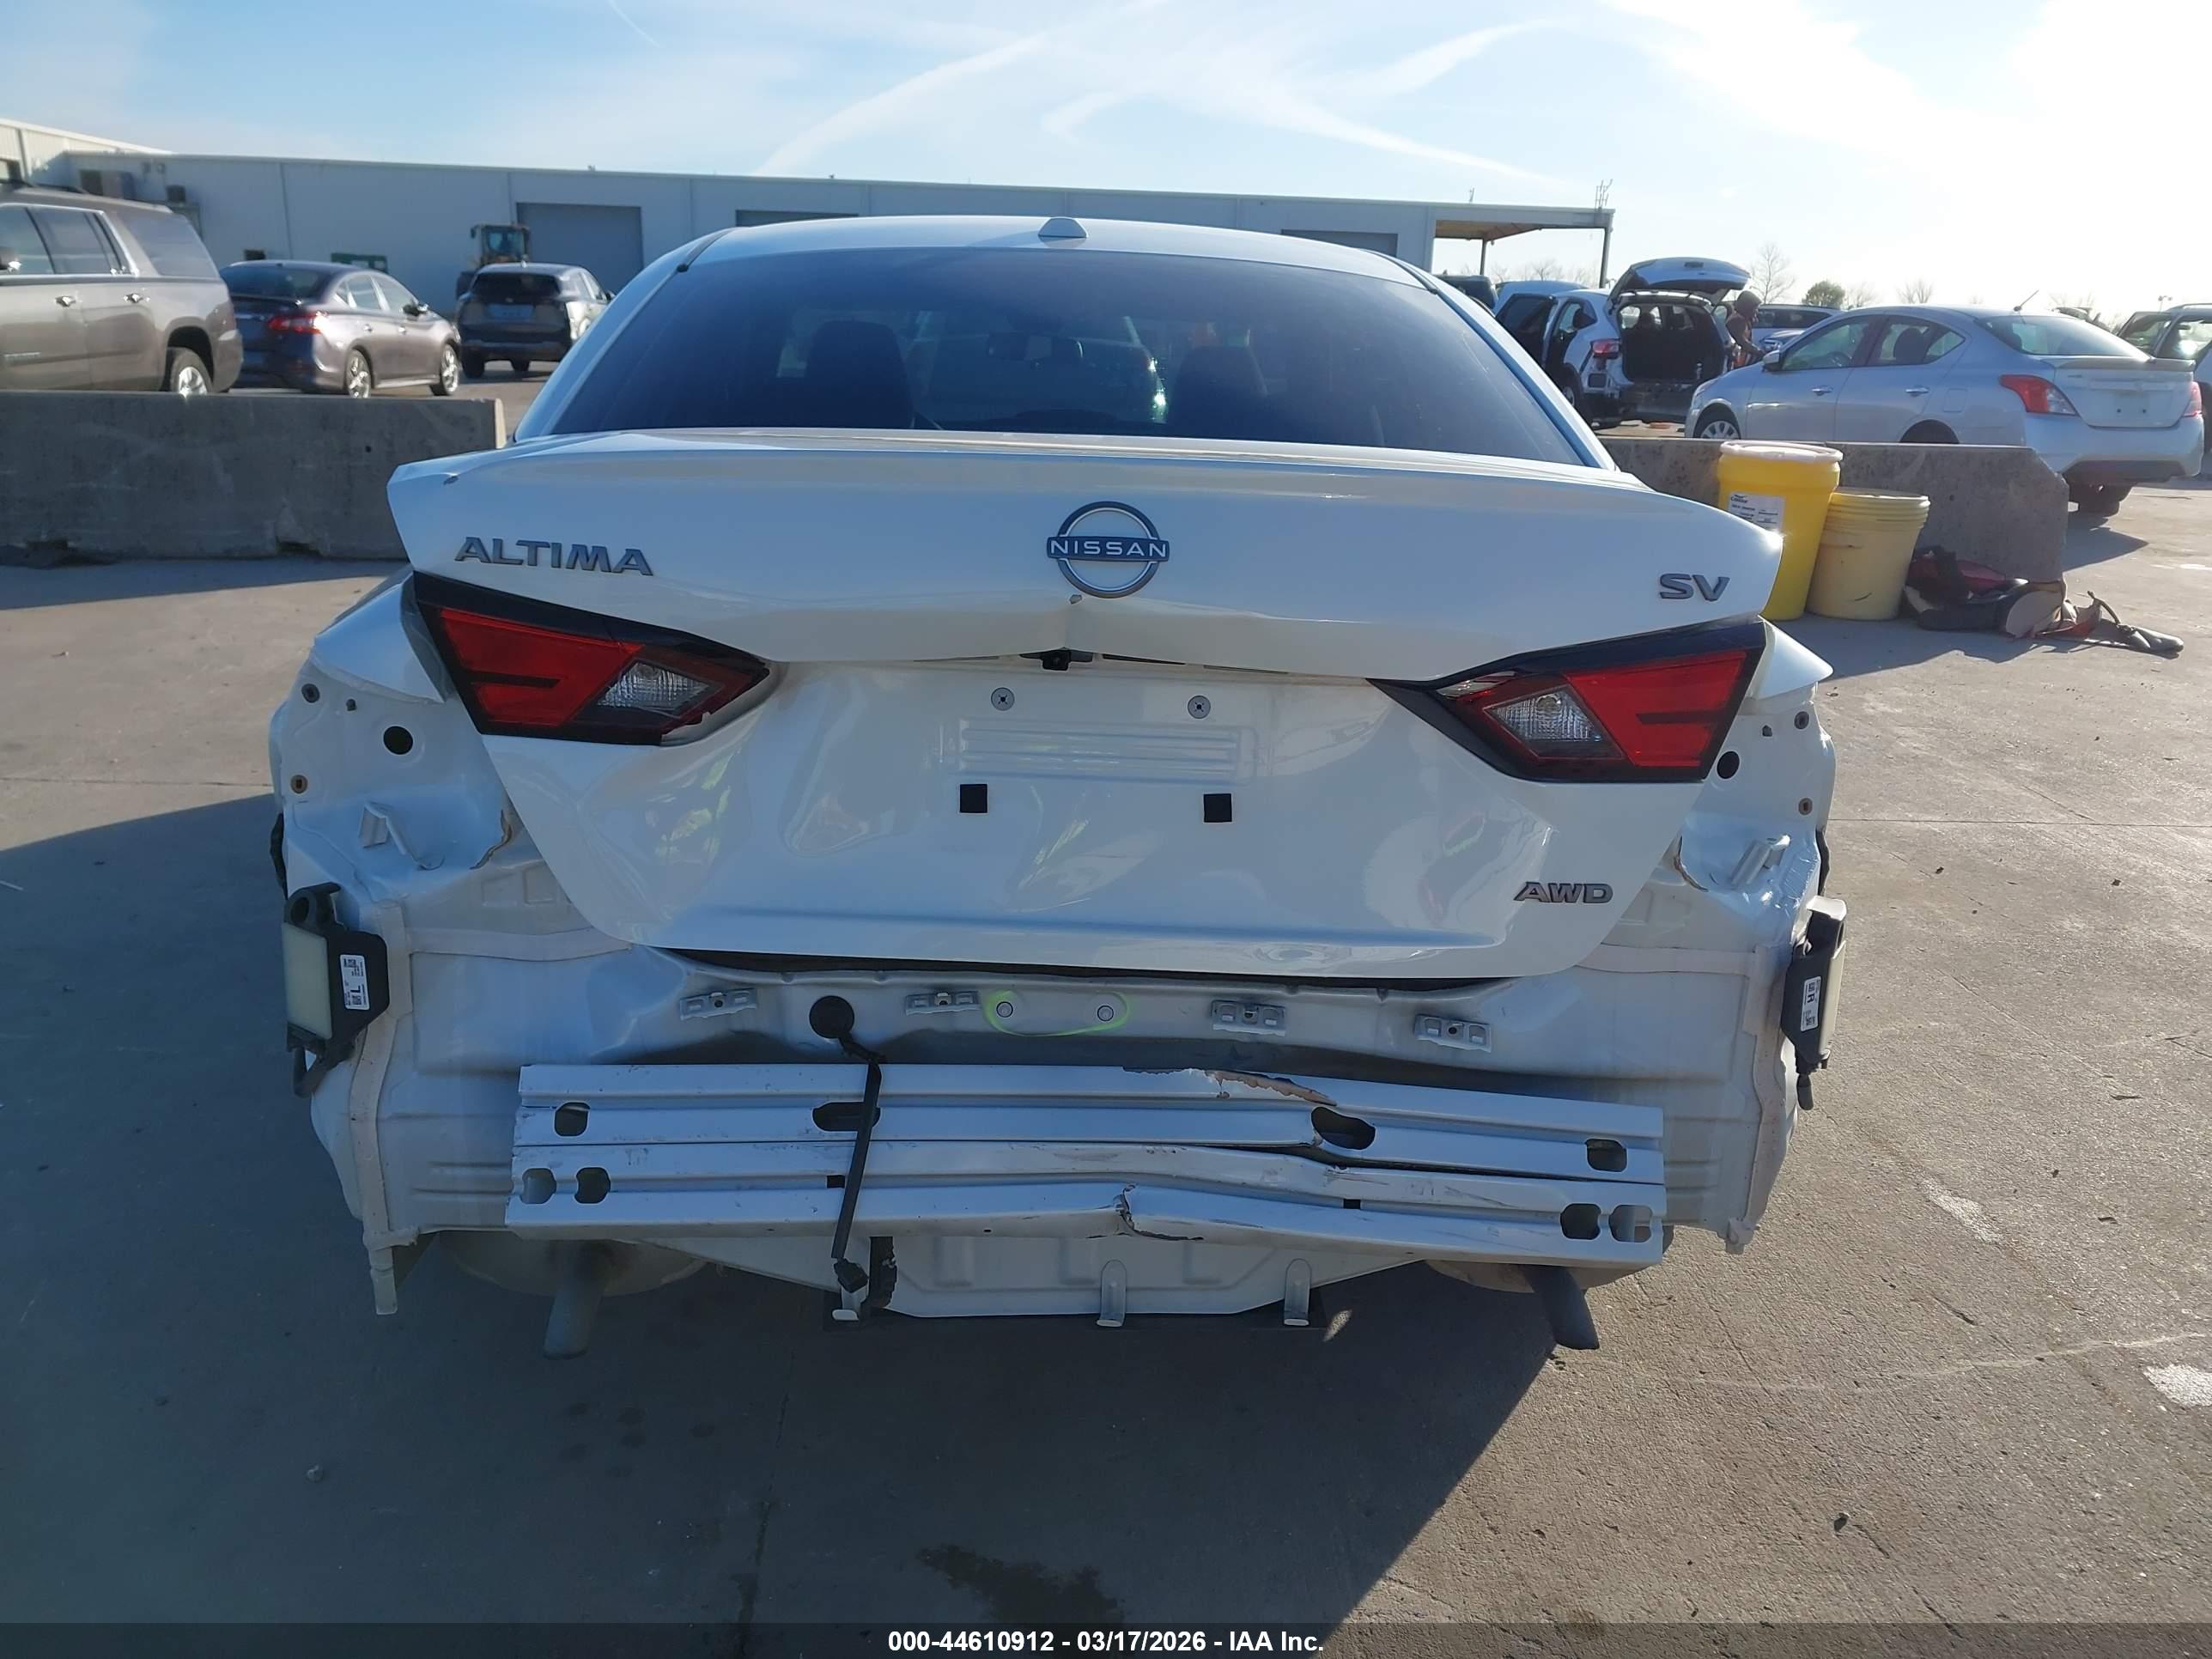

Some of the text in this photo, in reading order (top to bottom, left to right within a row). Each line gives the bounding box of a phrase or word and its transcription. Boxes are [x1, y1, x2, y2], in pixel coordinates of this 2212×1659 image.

[454, 537, 653, 576] ALTIMA
[1050, 540, 1166, 557] NISSAN
[1660, 573, 1731, 602] SV
[1513, 881, 1614, 904] AWD
